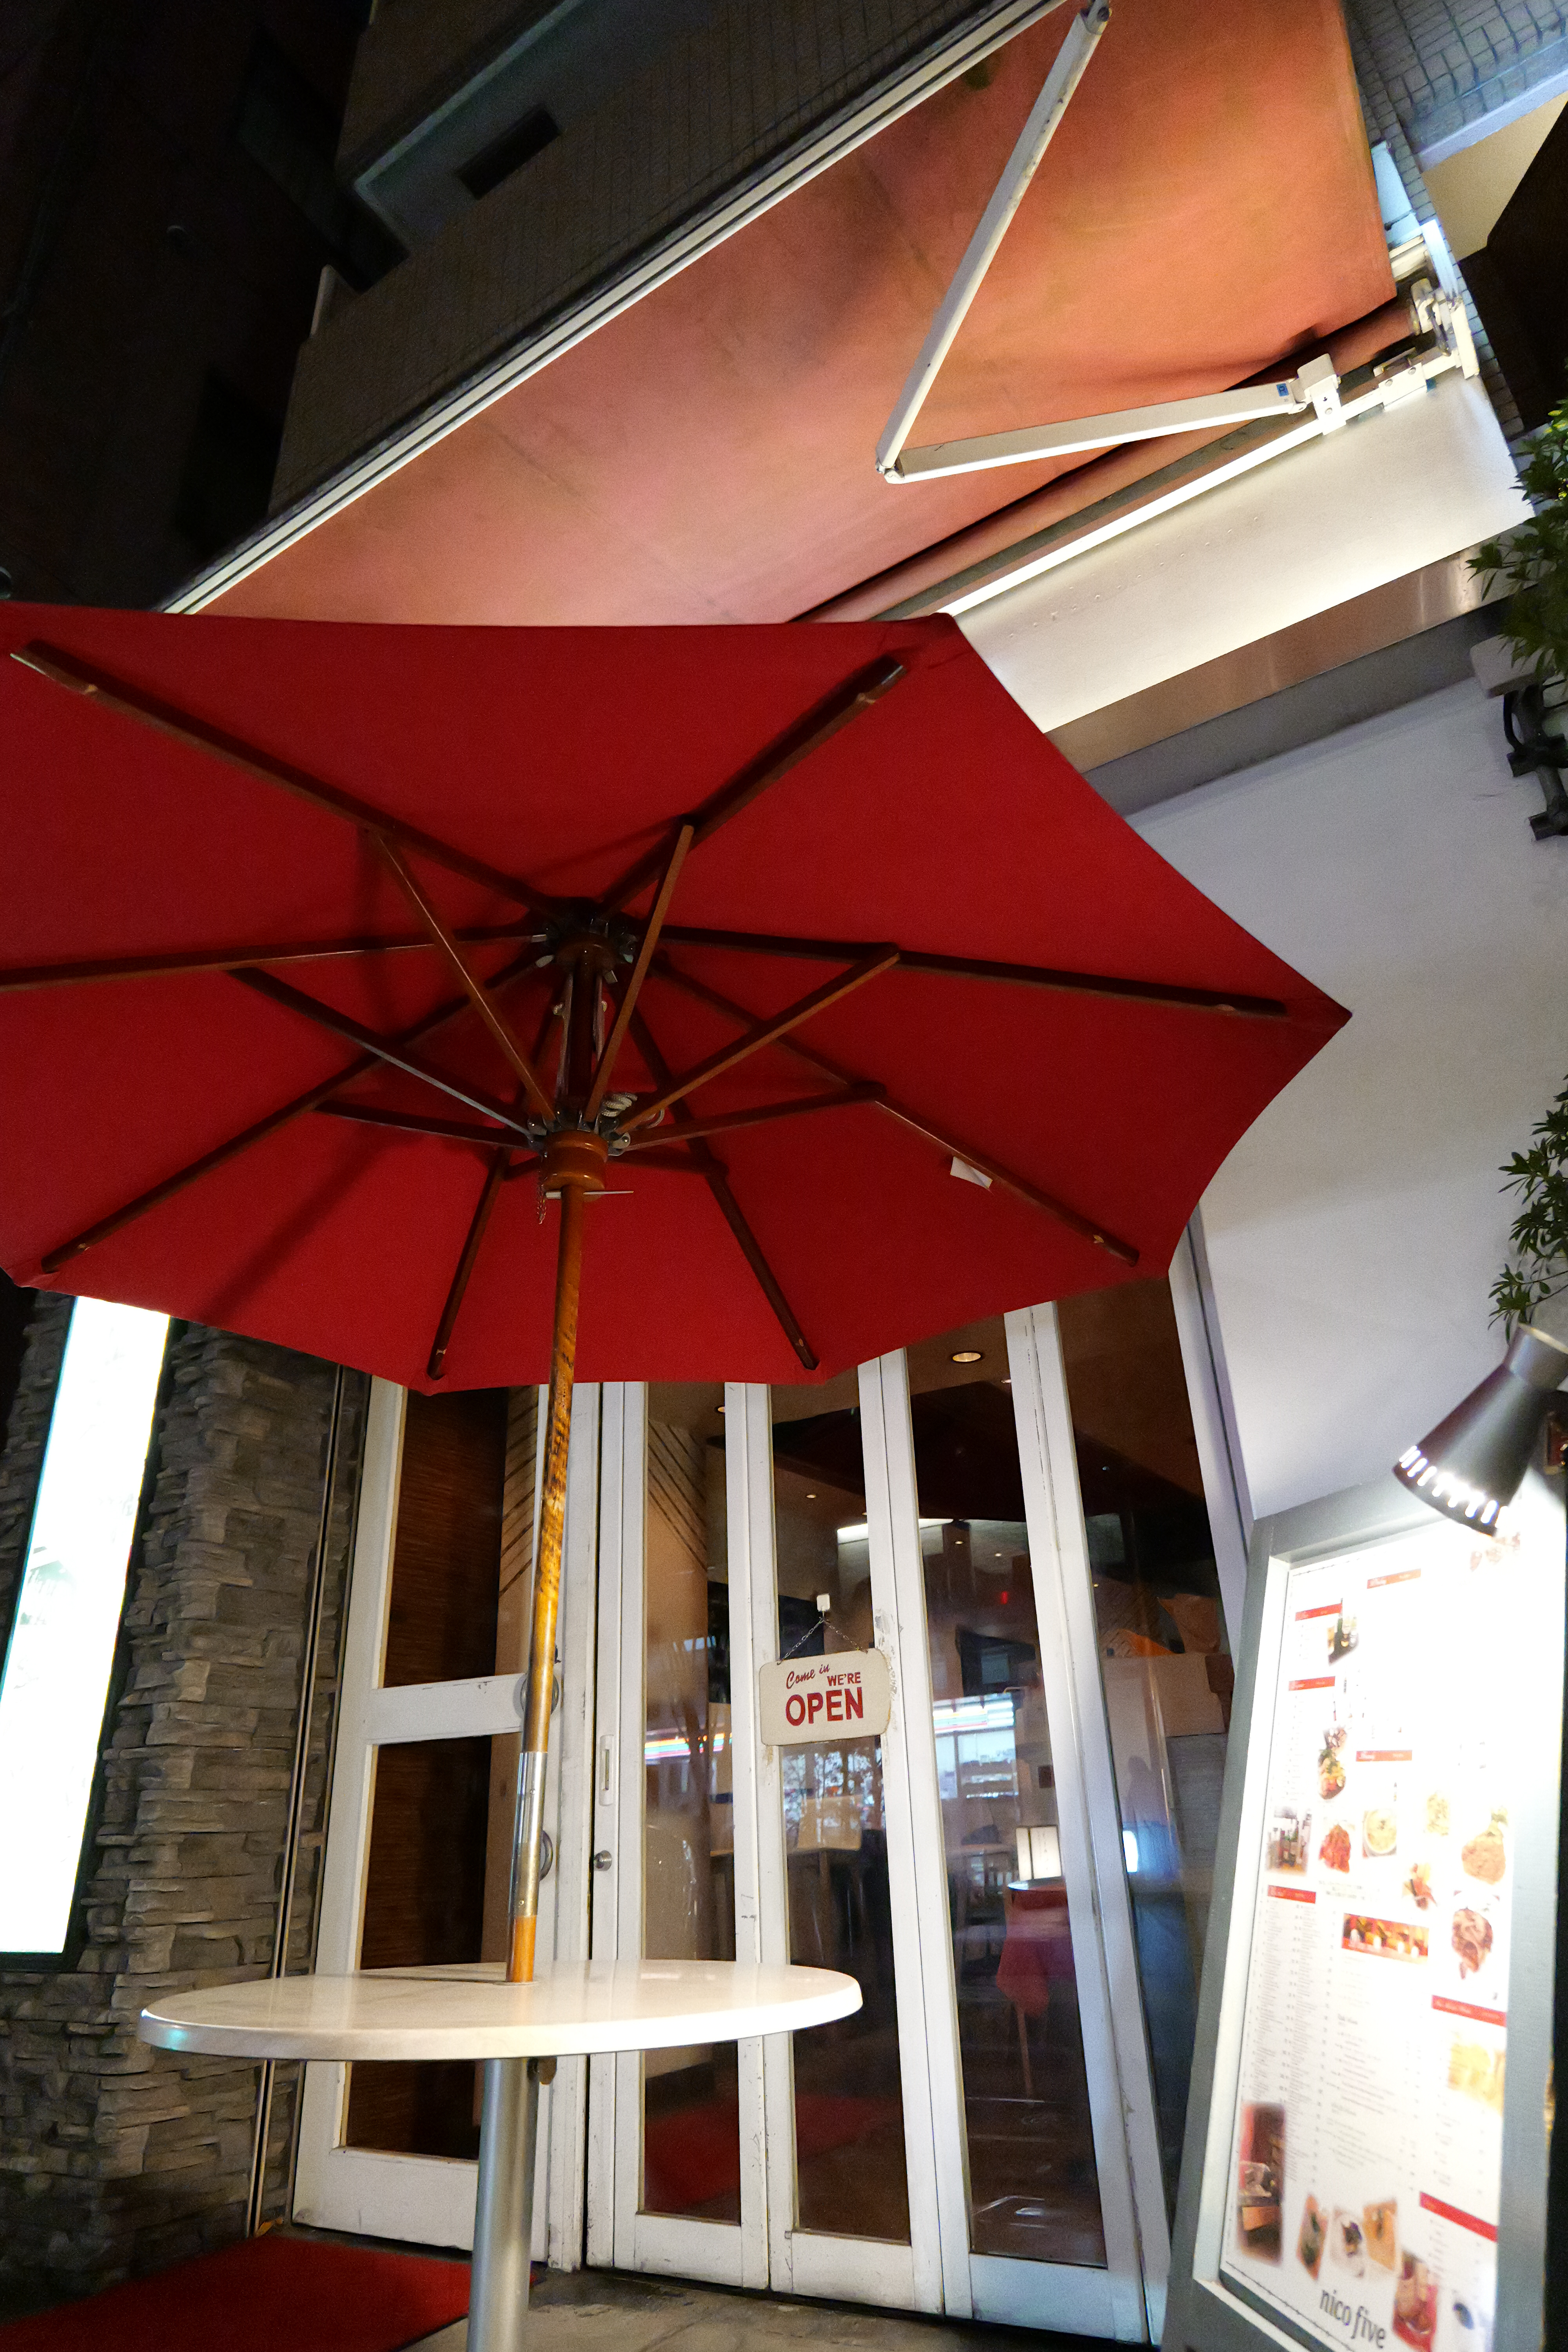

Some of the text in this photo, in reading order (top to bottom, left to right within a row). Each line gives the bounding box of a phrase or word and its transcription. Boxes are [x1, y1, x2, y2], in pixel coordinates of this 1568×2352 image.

[786, 1664, 830, 1690] Come in
[785, 1686, 864, 1727] OPEN
[1319, 2289, 1386, 2349] nico five
